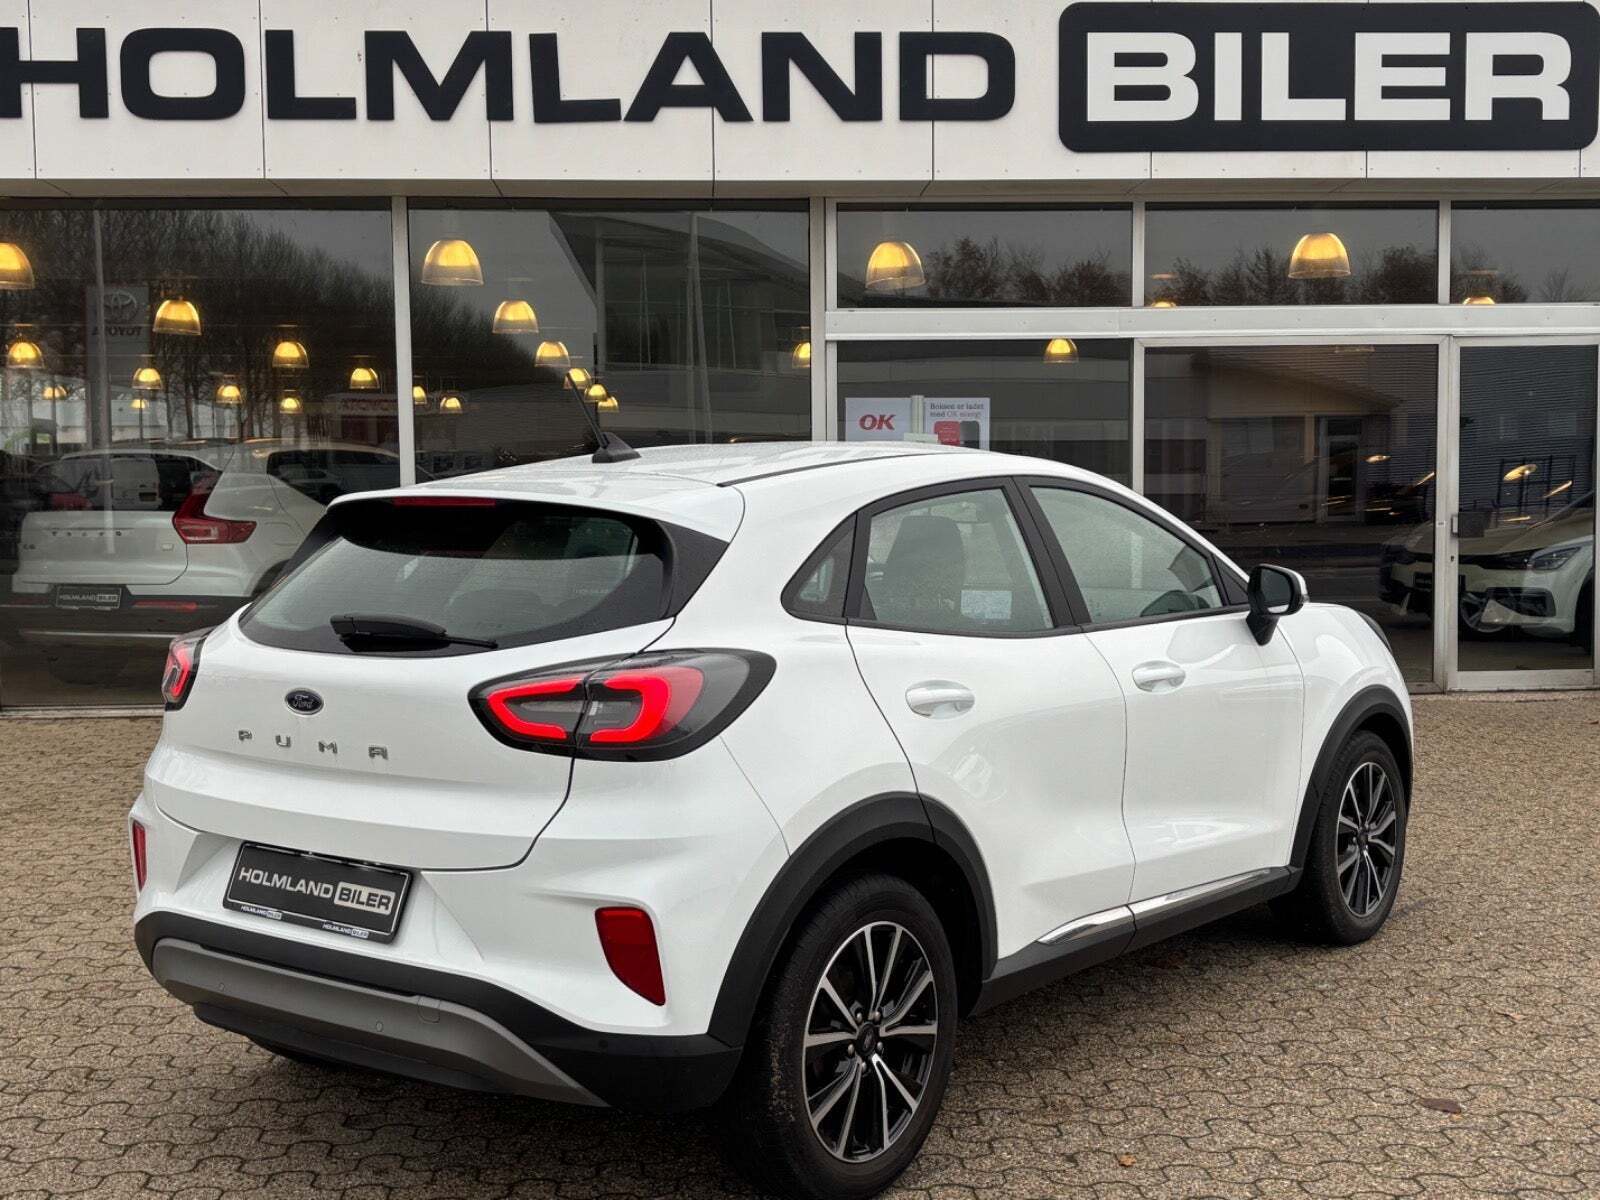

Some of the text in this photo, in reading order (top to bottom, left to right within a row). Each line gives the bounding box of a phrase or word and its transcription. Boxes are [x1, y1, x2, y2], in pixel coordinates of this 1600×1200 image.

[0, 27, 1572, 123] HOLMLAND BILER
[859, 414, 896, 431] OK
[293, 693, 314, 710] Ford
[238, 730, 388, 760] PUMA
[239, 867, 392, 911] HOLMLAND BILER
[240, 905, 268, 917] HOLMLAND
[322, 923, 351, 935] HOLMLAND
